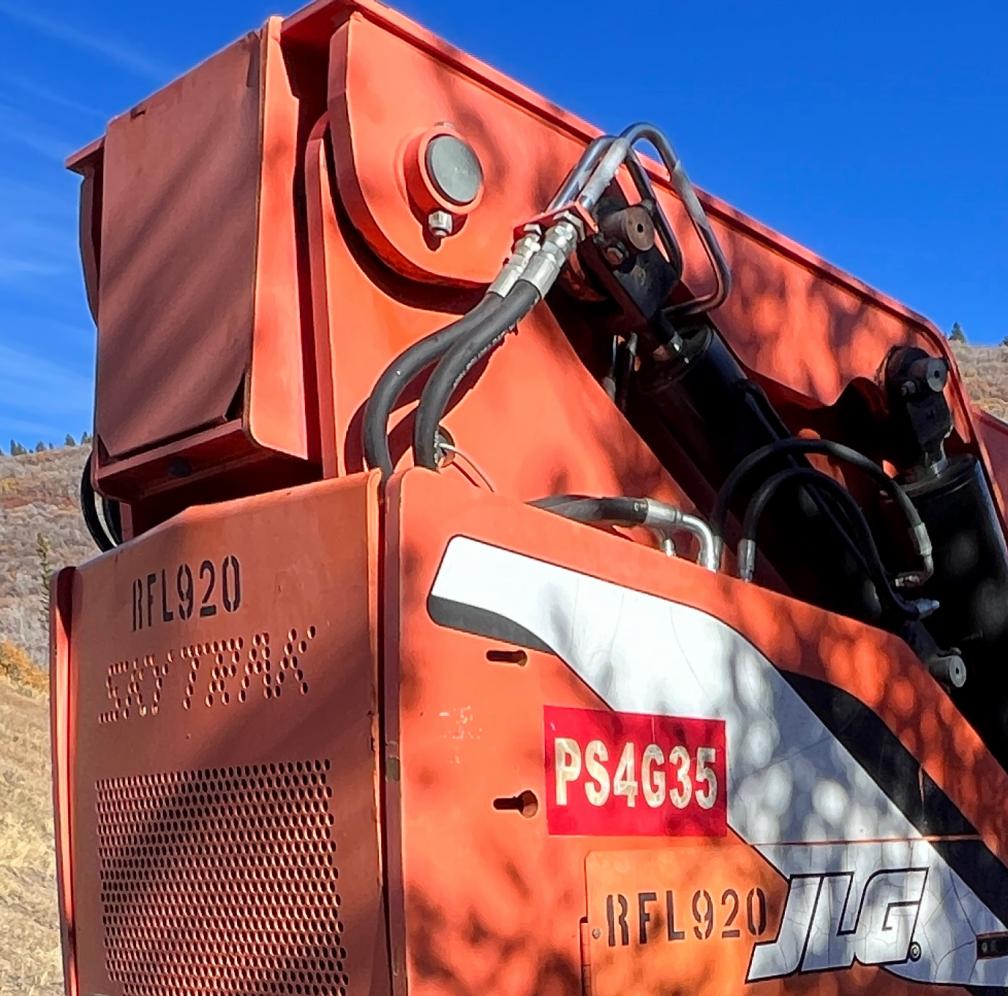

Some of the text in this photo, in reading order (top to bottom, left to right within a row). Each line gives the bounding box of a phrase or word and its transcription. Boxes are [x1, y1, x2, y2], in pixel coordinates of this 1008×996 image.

[132, 555, 241, 632] RFL920
[554, 737, 717, 809] PS4G35
[606, 887, 767, 948] RFL920
